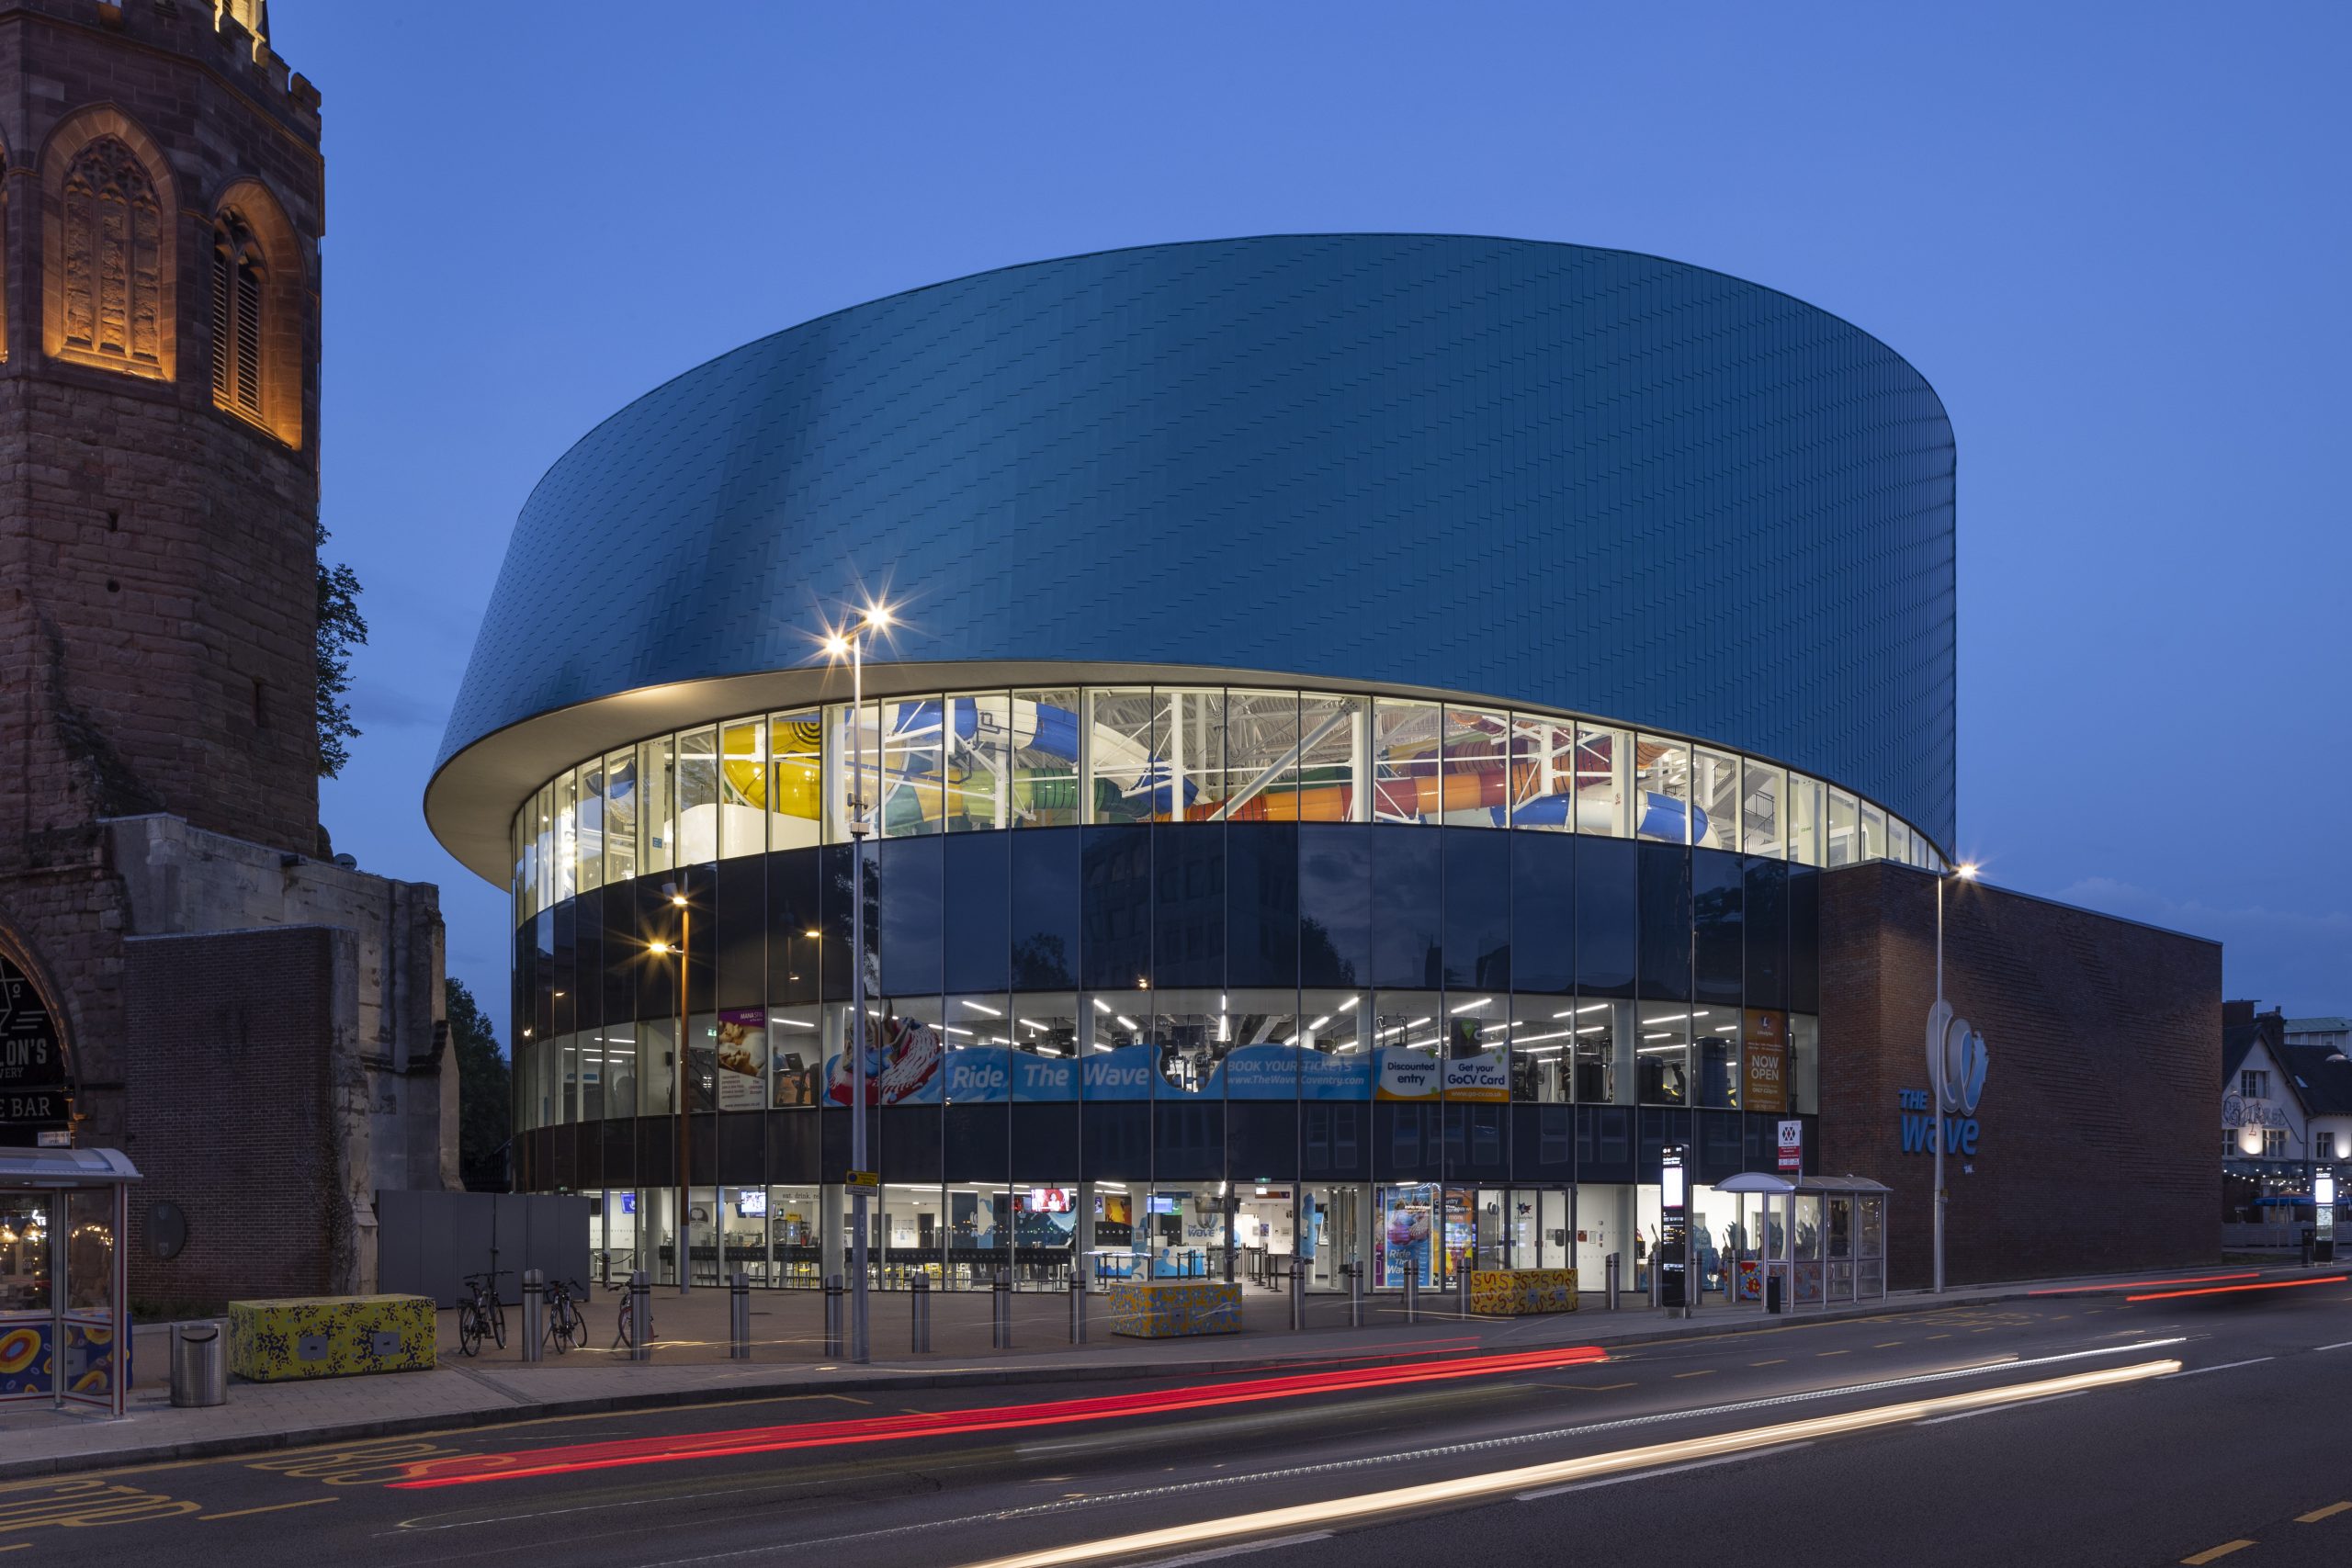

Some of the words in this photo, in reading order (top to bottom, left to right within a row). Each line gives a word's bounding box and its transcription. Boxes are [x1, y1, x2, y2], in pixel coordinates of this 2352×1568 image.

[0, 1038, 47, 1066] ON'S
[1227, 1061, 1261, 1072] BOOK
[1265, 1061, 1298, 1072] YOUR
[1301, 1060, 1353, 1072] TICKETS
[1387, 1062, 1435, 1071] Discounted
[1458, 1063, 1473, 1072] Get
[1476, 1065, 1494, 1074] your
[1752, 1055, 1780, 1069] NOW
[953, 1064, 1004, 1089] Ride
[1023, 1063, 1069, 1087] The
[1083, 1063, 1149, 1086] Wave
[1397, 1074, 1426, 1086] entry
[1448, 1075, 1476, 1085] GoCV
[1480, 1075, 1505, 1085] Card
[1751, 1067, 1780, 1081] OPEN
[1898, 1088, 1928, 1111] THE
[12, 1097, 51, 1118] BAR
[1390, 1249, 1411, 1258] Ride
[243, 1442, 517, 1486] BUS
